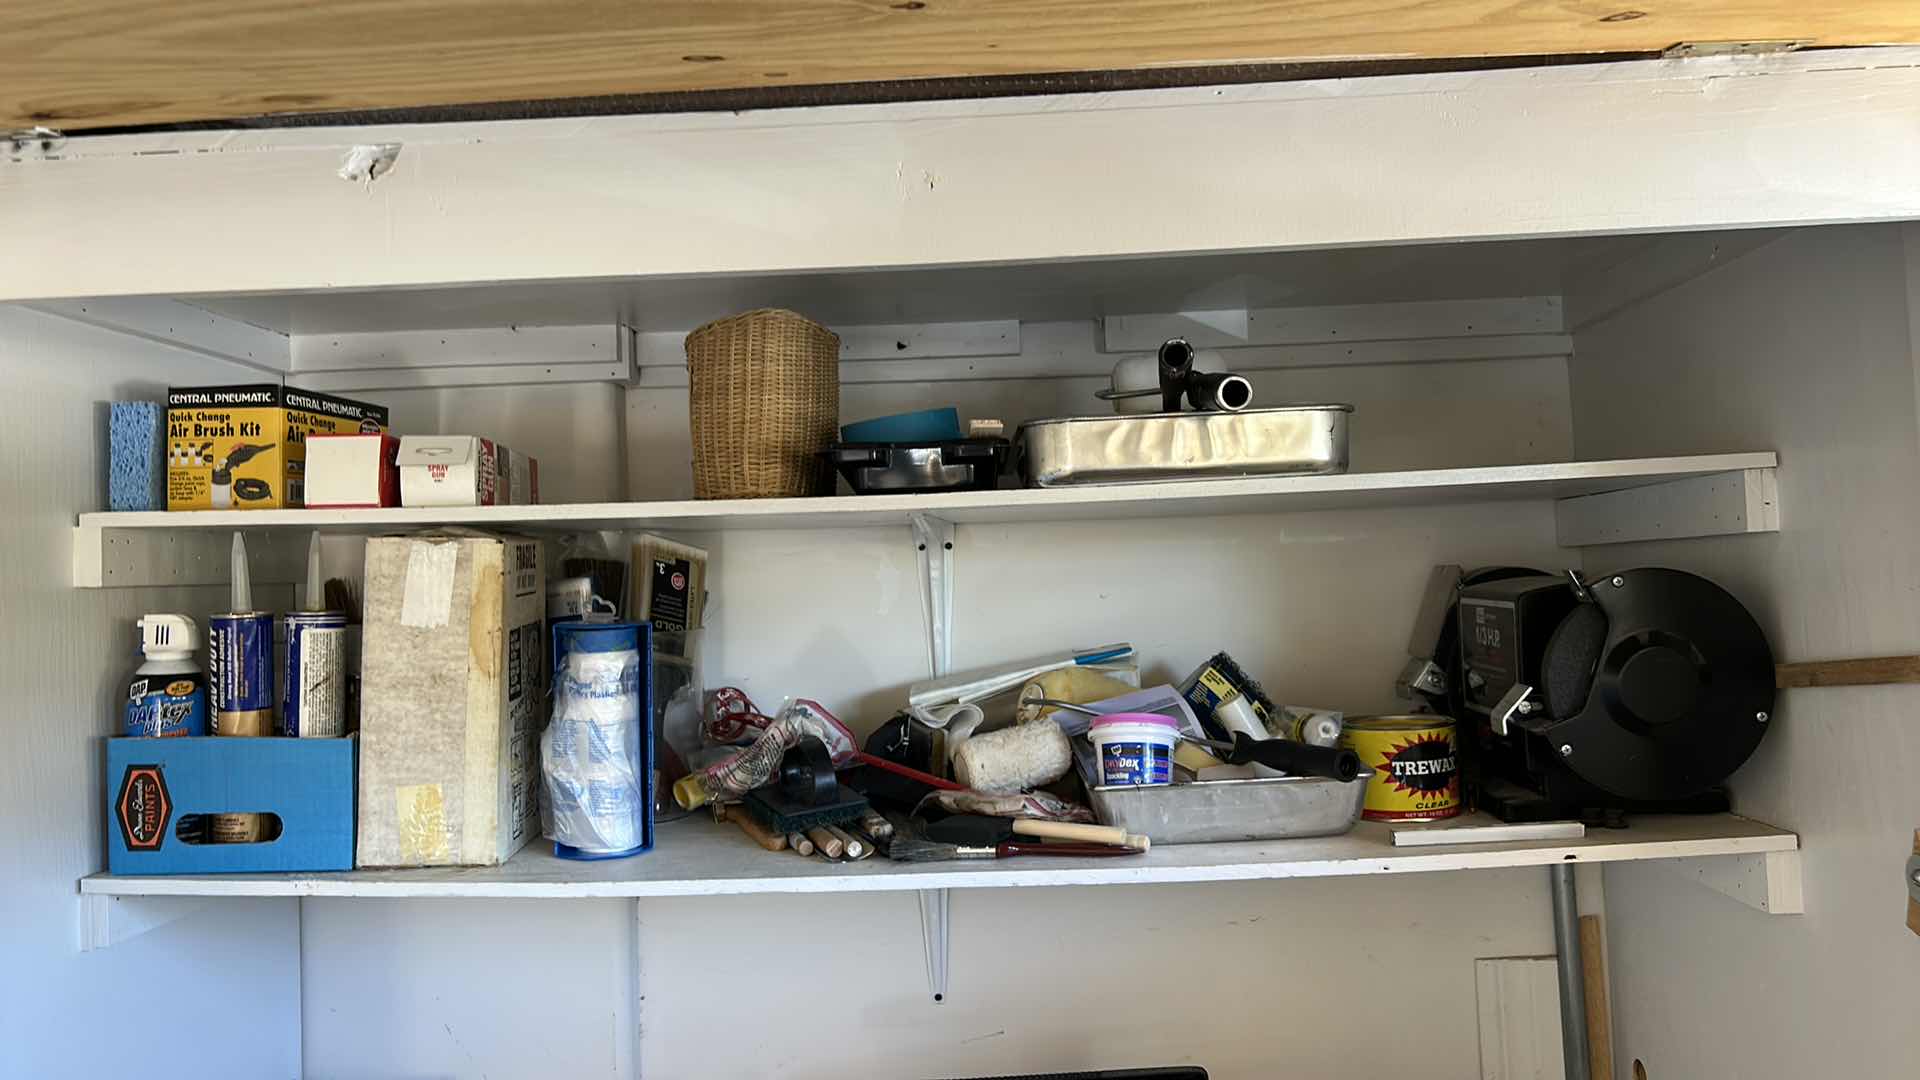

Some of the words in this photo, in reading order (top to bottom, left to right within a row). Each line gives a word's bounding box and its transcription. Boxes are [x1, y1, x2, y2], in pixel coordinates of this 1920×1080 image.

[169, 393, 212, 404] CENTRAL
[214, 391, 271, 403] PNEUMATIC
[286, 394, 321, 410] CENTRAL
[322, 401, 362, 418] PNEUMATIC
[169, 411, 193, 422] Quick
[196, 411, 231, 424] Change
[286, 411, 308, 425] Quick
[310, 415, 336, 432] Change
[170, 423, 189, 438] Air
[194, 422, 234, 437] Brush
[240, 421, 261, 436] Kit
[287, 425, 305, 442] Air
[427, 464, 448, 472] SPRAY
[209, 627, 217, 672] DUTY
[209, 673, 218, 729] HEAVY
[1391, 757, 1455, 775] TREWAX
[144, 783, 156, 832] PAINTS
[1415, 800, 1449, 809] CLEAR
